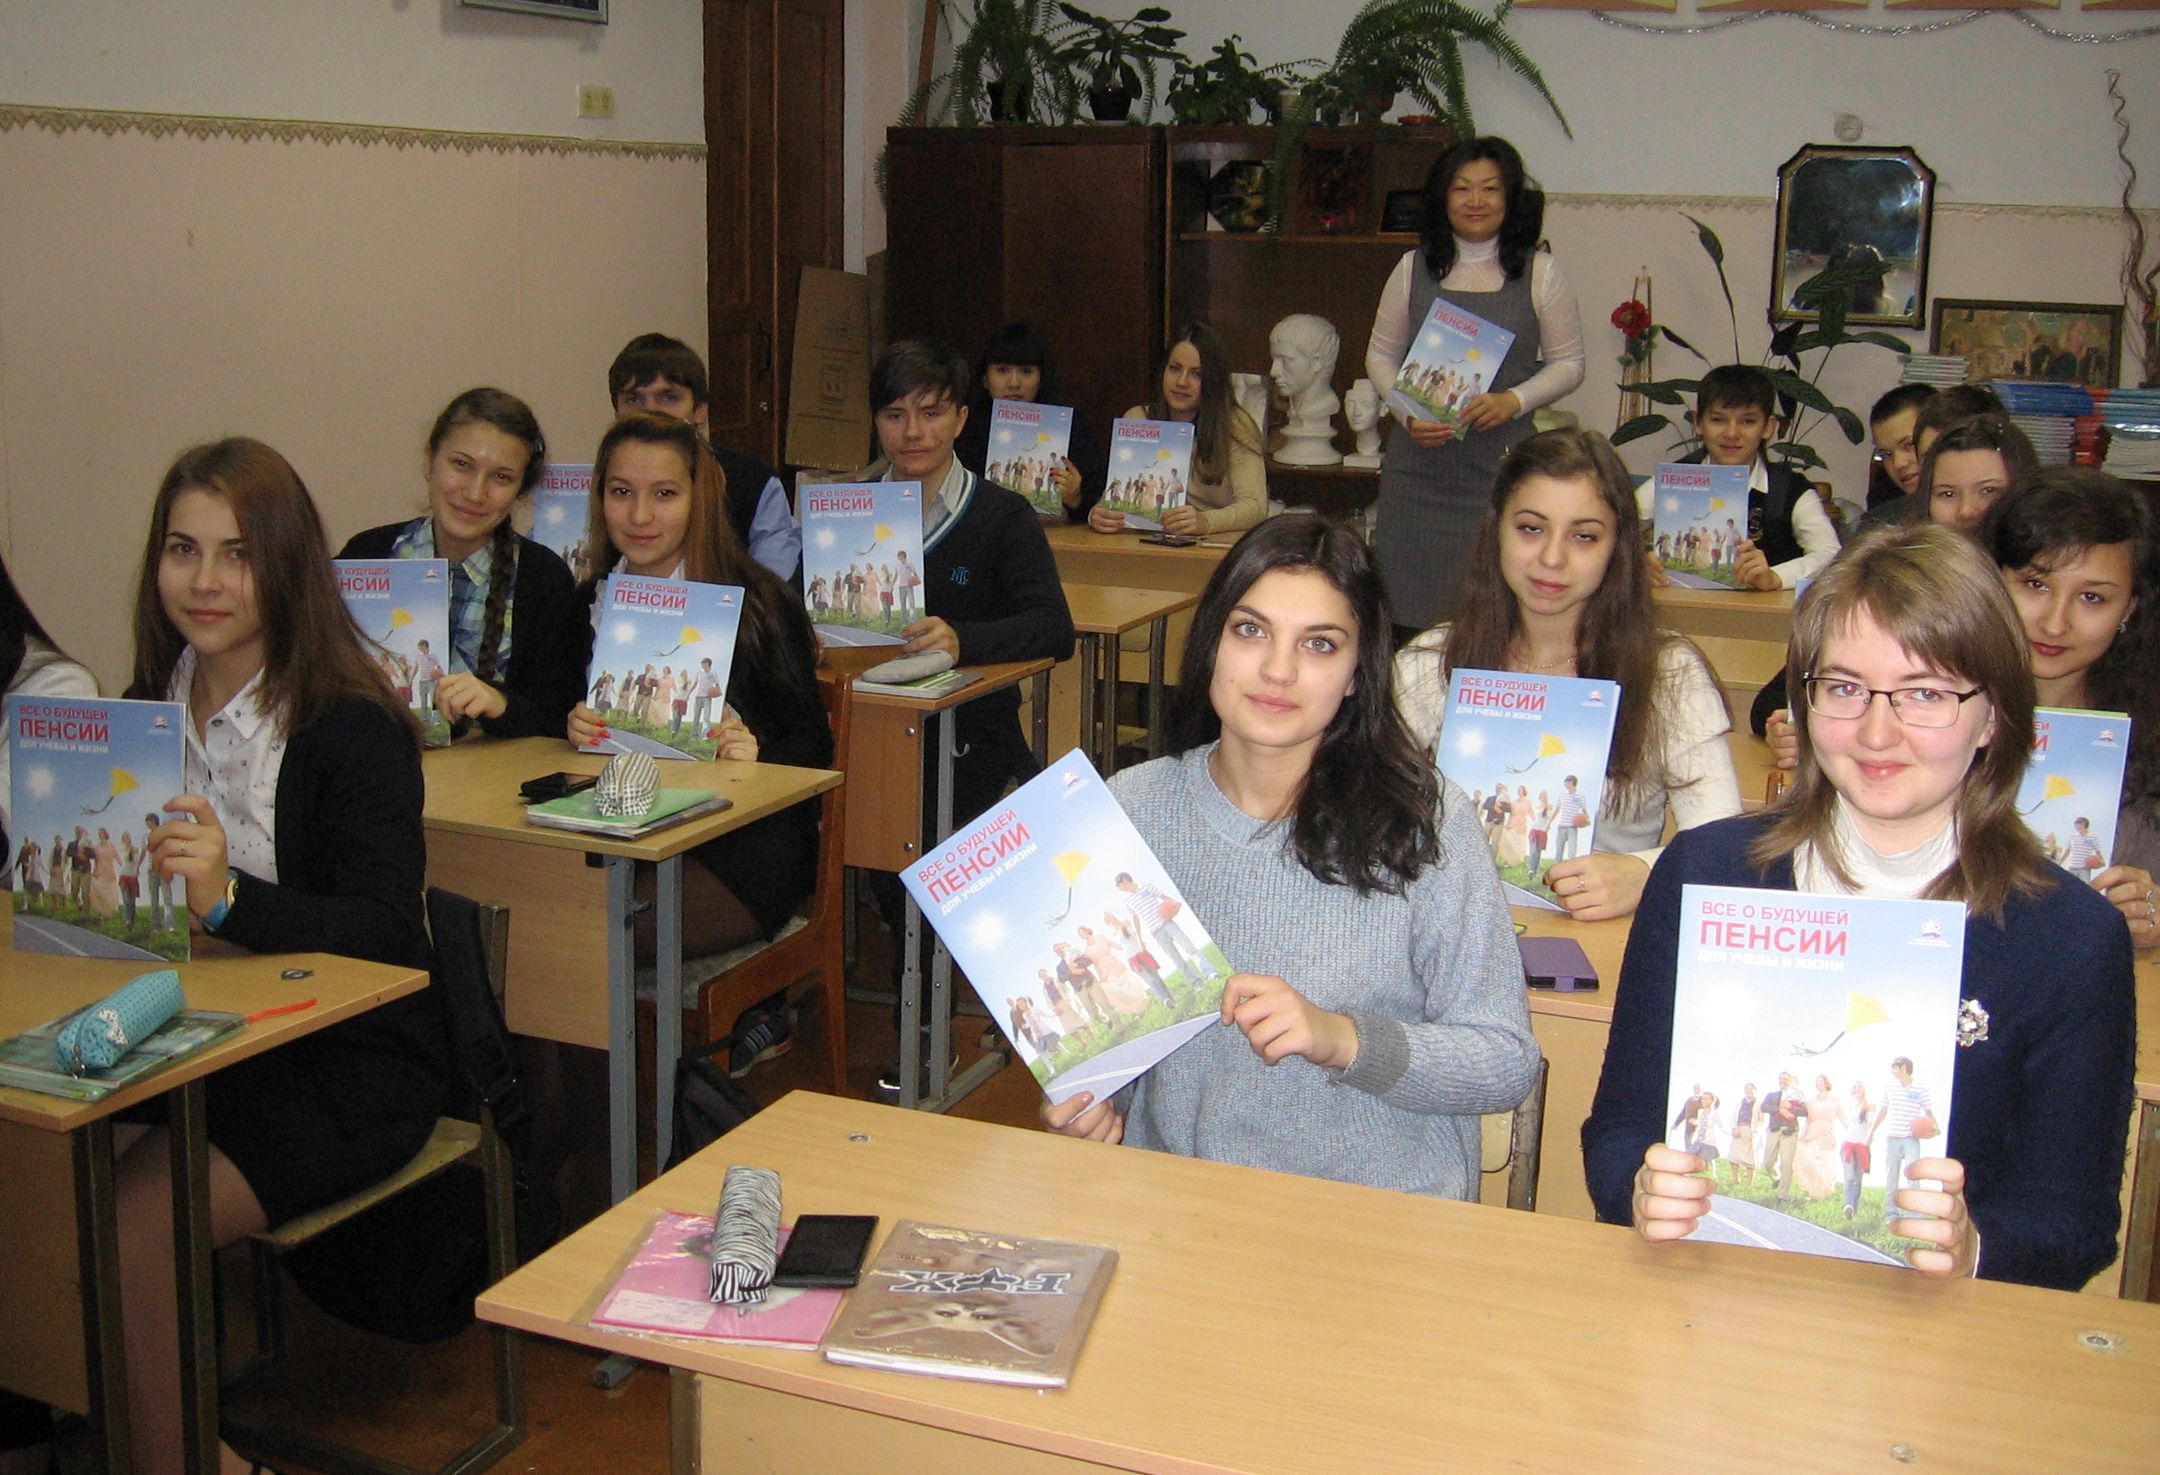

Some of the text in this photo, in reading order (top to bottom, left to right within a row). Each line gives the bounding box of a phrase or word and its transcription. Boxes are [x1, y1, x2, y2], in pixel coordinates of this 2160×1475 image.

[541, 478, 592, 489] ПЕНСИ
[810, 498, 873, 511] ПЕНСИИ
[338, 577, 391, 591] НСИИ
[614, 589, 687, 610] ПЕНСИИ
[1461, 676, 1547, 691] ВСЕ О БУДУЩЕЙ
[1458, 688, 1545, 711] ПЕНСИИ
[19, 704, 109, 720] ВСЕ О БУДУЩЕЙ
[19, 718, 110, 743] ПЕНСИИ
[918, 808, 1017, 883] ВСЕ О БУДУЩЕЙ
[927, 822, 1031, 903] ПЕНСИИ
[940, 842, 1038, 916] ДЛЯ УЧЕБЫ И ЖИЗНИ
[1701, 901, 1848, 925] ВСЕ О БУДУЩЕЙ
[1700, 920, 1848, 956] ПЕНСИИ
[1698, 950, 1844, 972] ДЛЯ УЧЕБЫ И ЖИЗНИ
